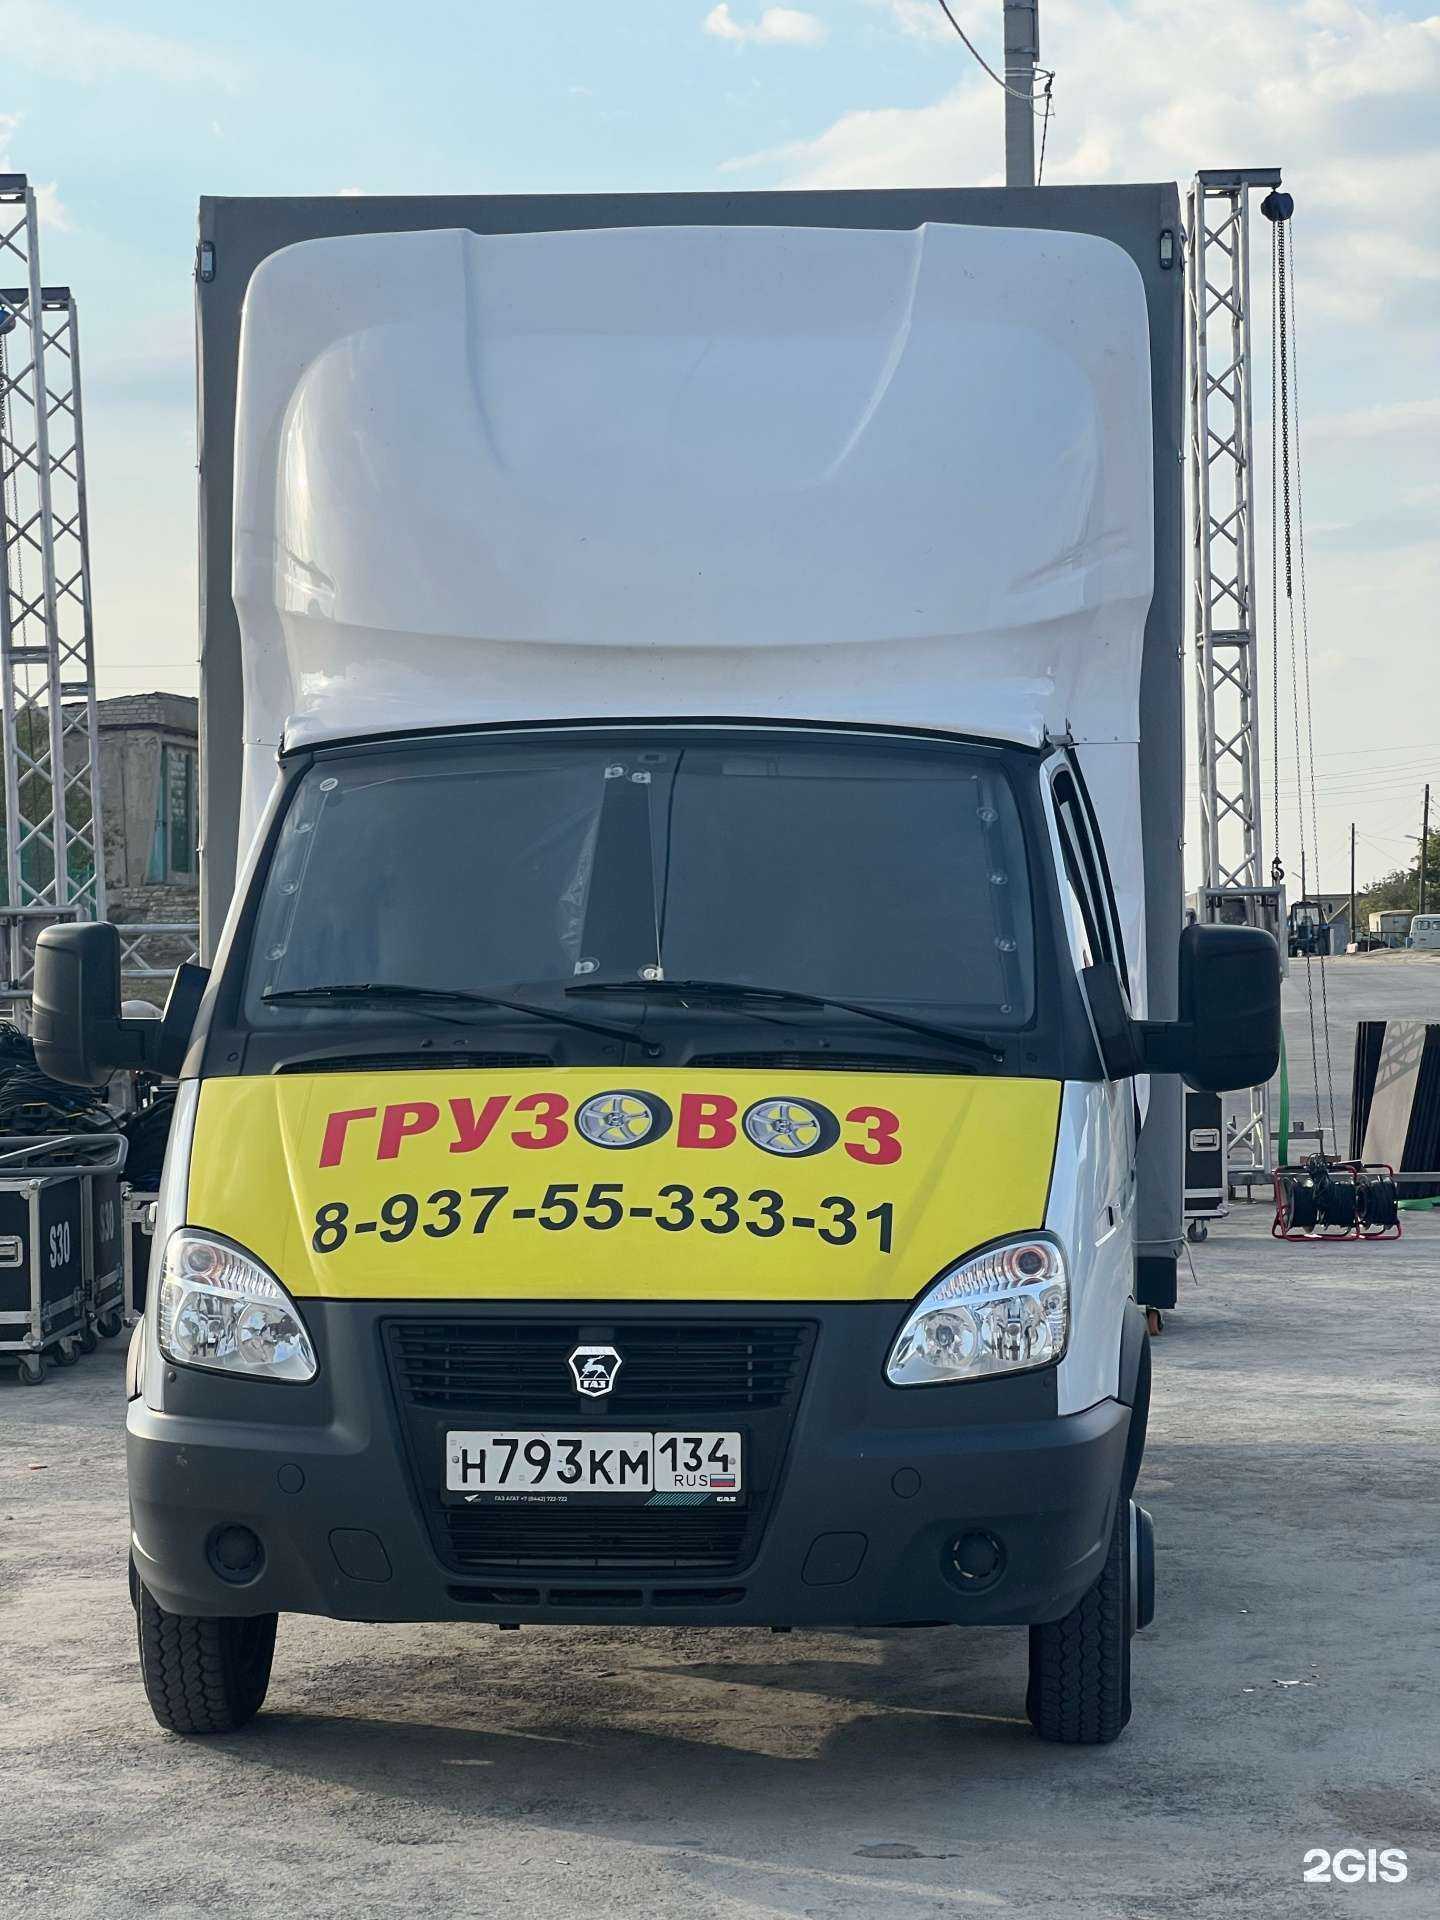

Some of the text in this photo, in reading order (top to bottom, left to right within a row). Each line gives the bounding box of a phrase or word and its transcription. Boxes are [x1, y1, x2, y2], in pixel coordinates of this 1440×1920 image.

[311, 1183, 894, 1254] 8-937-55-333-31
[50, 1220, 71, 1269] S30
[583, 1380, 606, 1388] ГАЗ
[658, 1437, 729, 1473] 134
[674, 1474, 709, 1487] RUS
